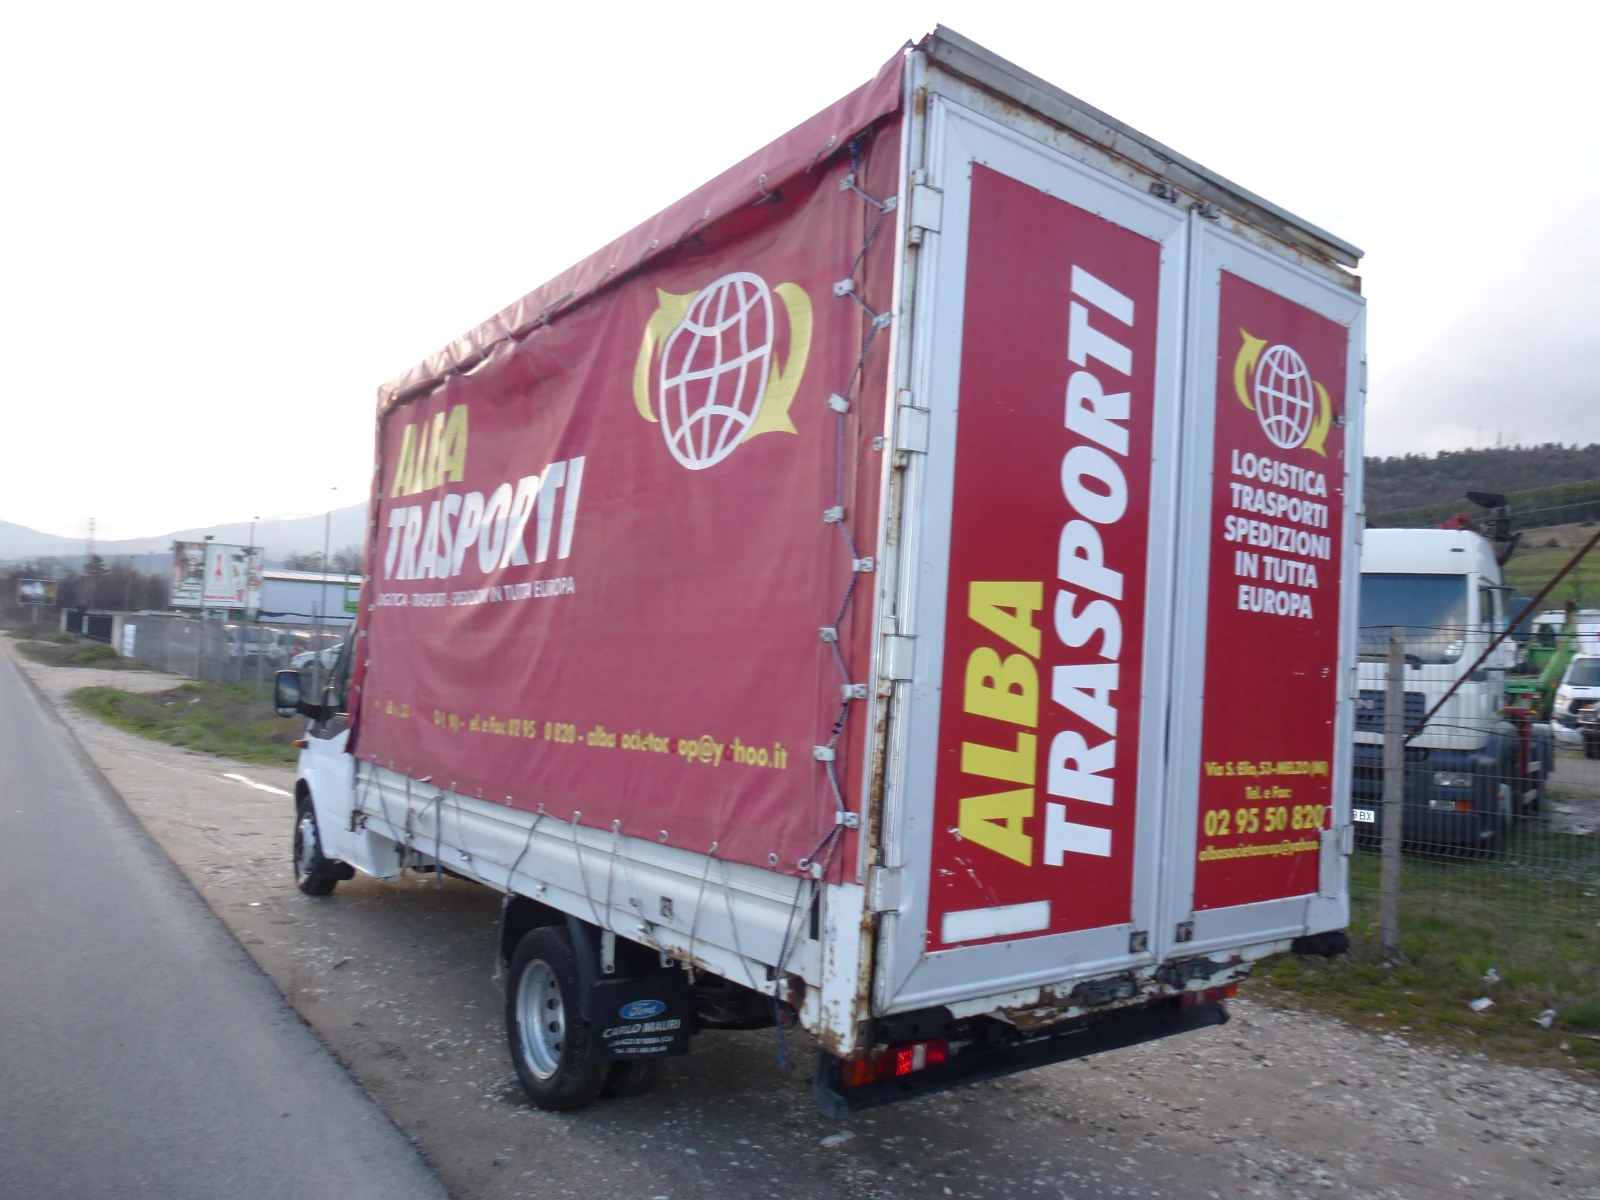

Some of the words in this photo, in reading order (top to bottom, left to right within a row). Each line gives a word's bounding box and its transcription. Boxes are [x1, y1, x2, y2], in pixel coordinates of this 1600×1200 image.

[1231, 449, 1328, 498] LOGISTICA
[384, 455, 586, 581] TRASPORTI
[1230, 482, 1328, 529] TRASPORTI
[1224, 515, 1331, 560] SPEDIZIONI
[1044, 264, 1135, 867] TRASPORTI
[1234, 550, 1259, 578] IN
[1263, 556, 1318, 588] TUTTA
[534, 576, 575, 598] EUROPA
[1238, 585, 1313, 619] EUROPA
[958, 580, 1044, 867] ALBA
[1204, 810, 1231, 837] 02
[1235, 808, 1261, 834] 95
[1264, 806, 1288, 832] 50
[1291, 804, 1325, 830] 820
[1359, 811, 1372, 822] BX
[602, 1024, 641, 1038] CARLO
